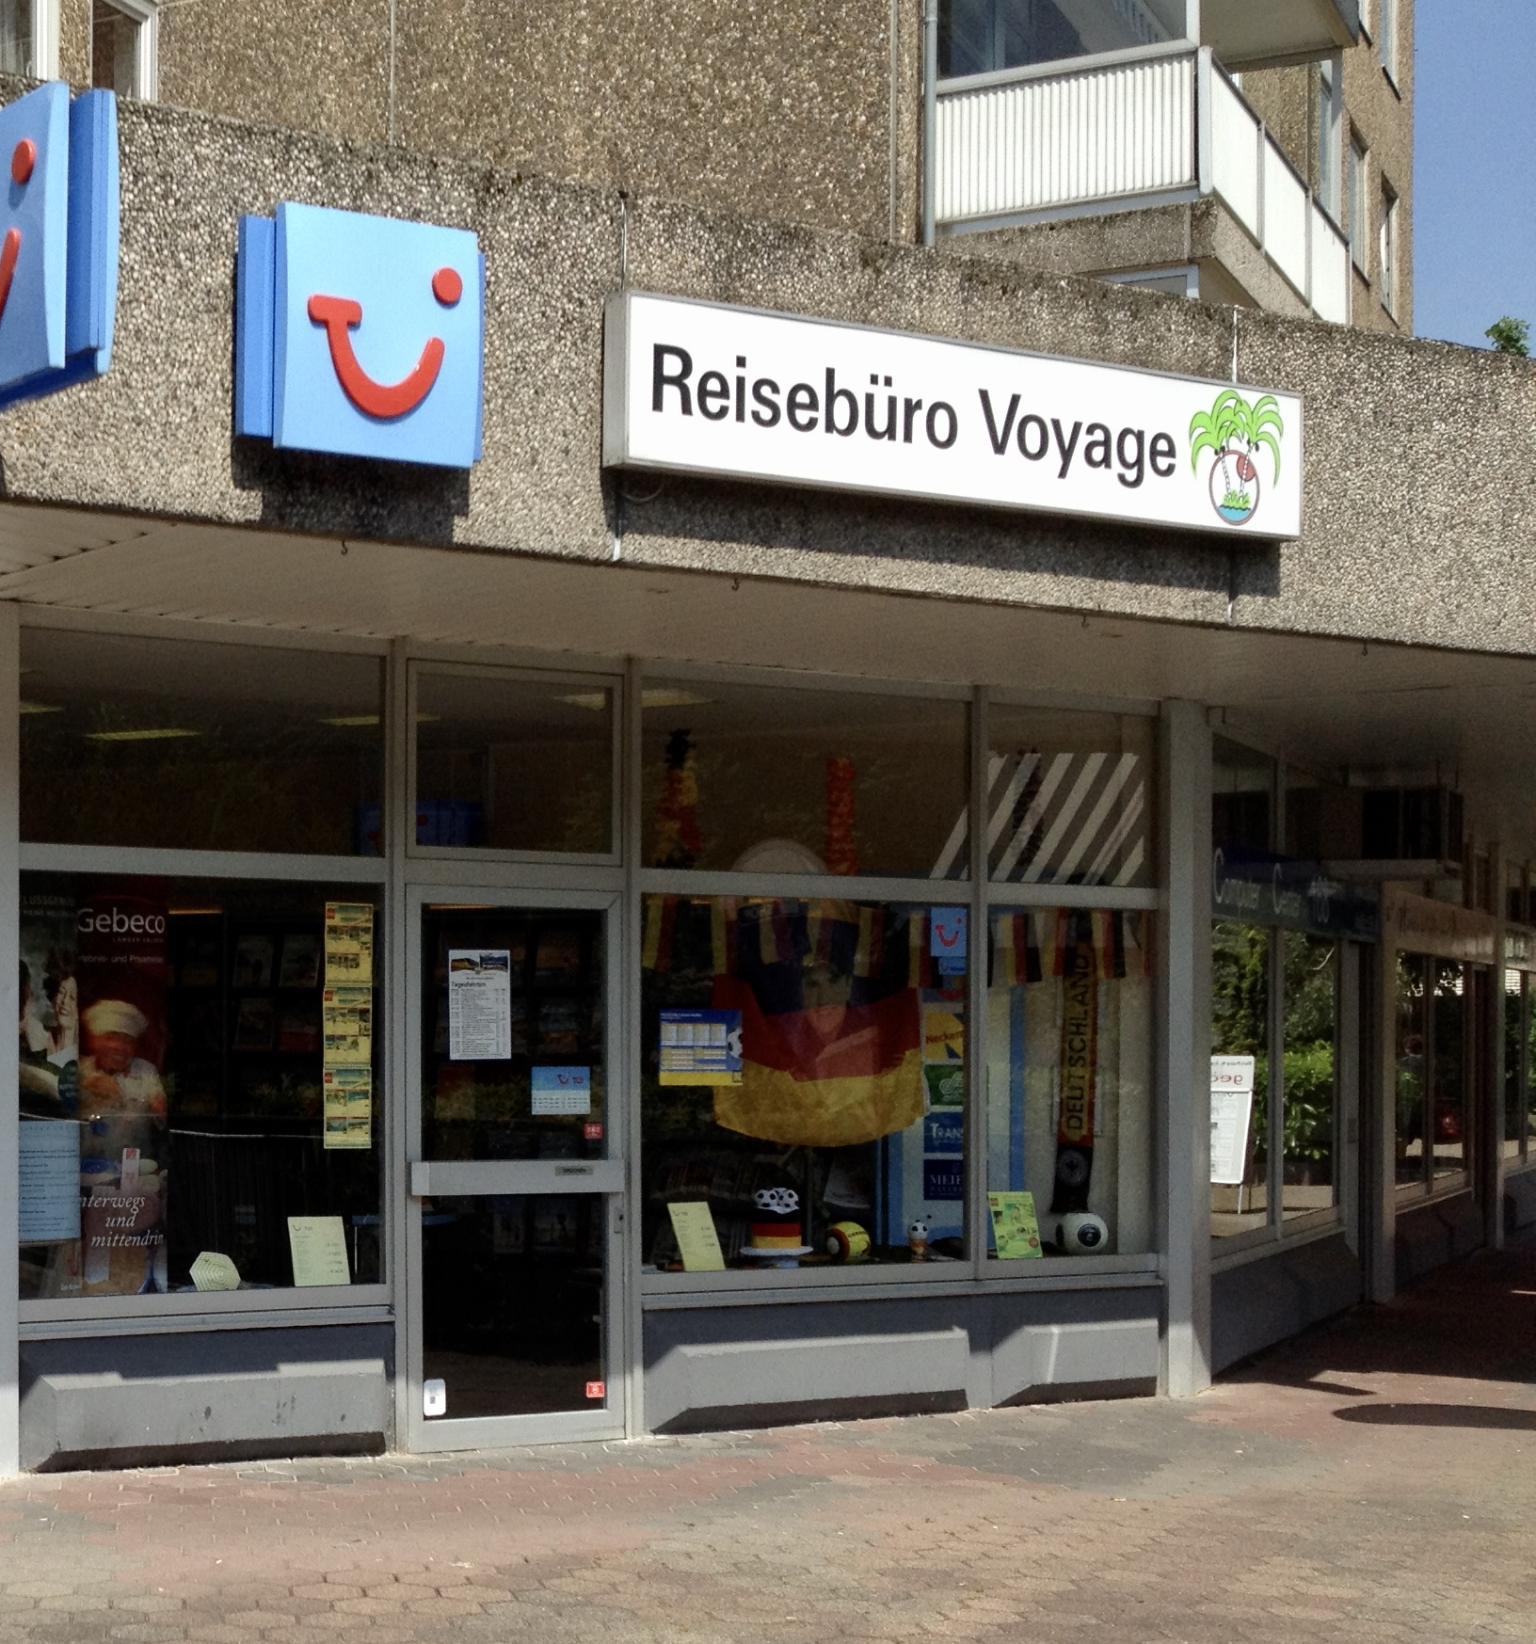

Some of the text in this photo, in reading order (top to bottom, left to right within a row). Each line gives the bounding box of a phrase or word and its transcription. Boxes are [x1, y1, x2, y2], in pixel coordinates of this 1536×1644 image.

[651, 342, 1177, 489] Reisebüro Voyage
[76, 906, 165, 934] Gebeco
[1066, 953, 1090, 1131] DEUTSCHLAND
[80, 1195, 145, 1216] nterwegs
[105, 1212, 136, 1228] und
[90, 1230, 165, 1248] mittendrin
